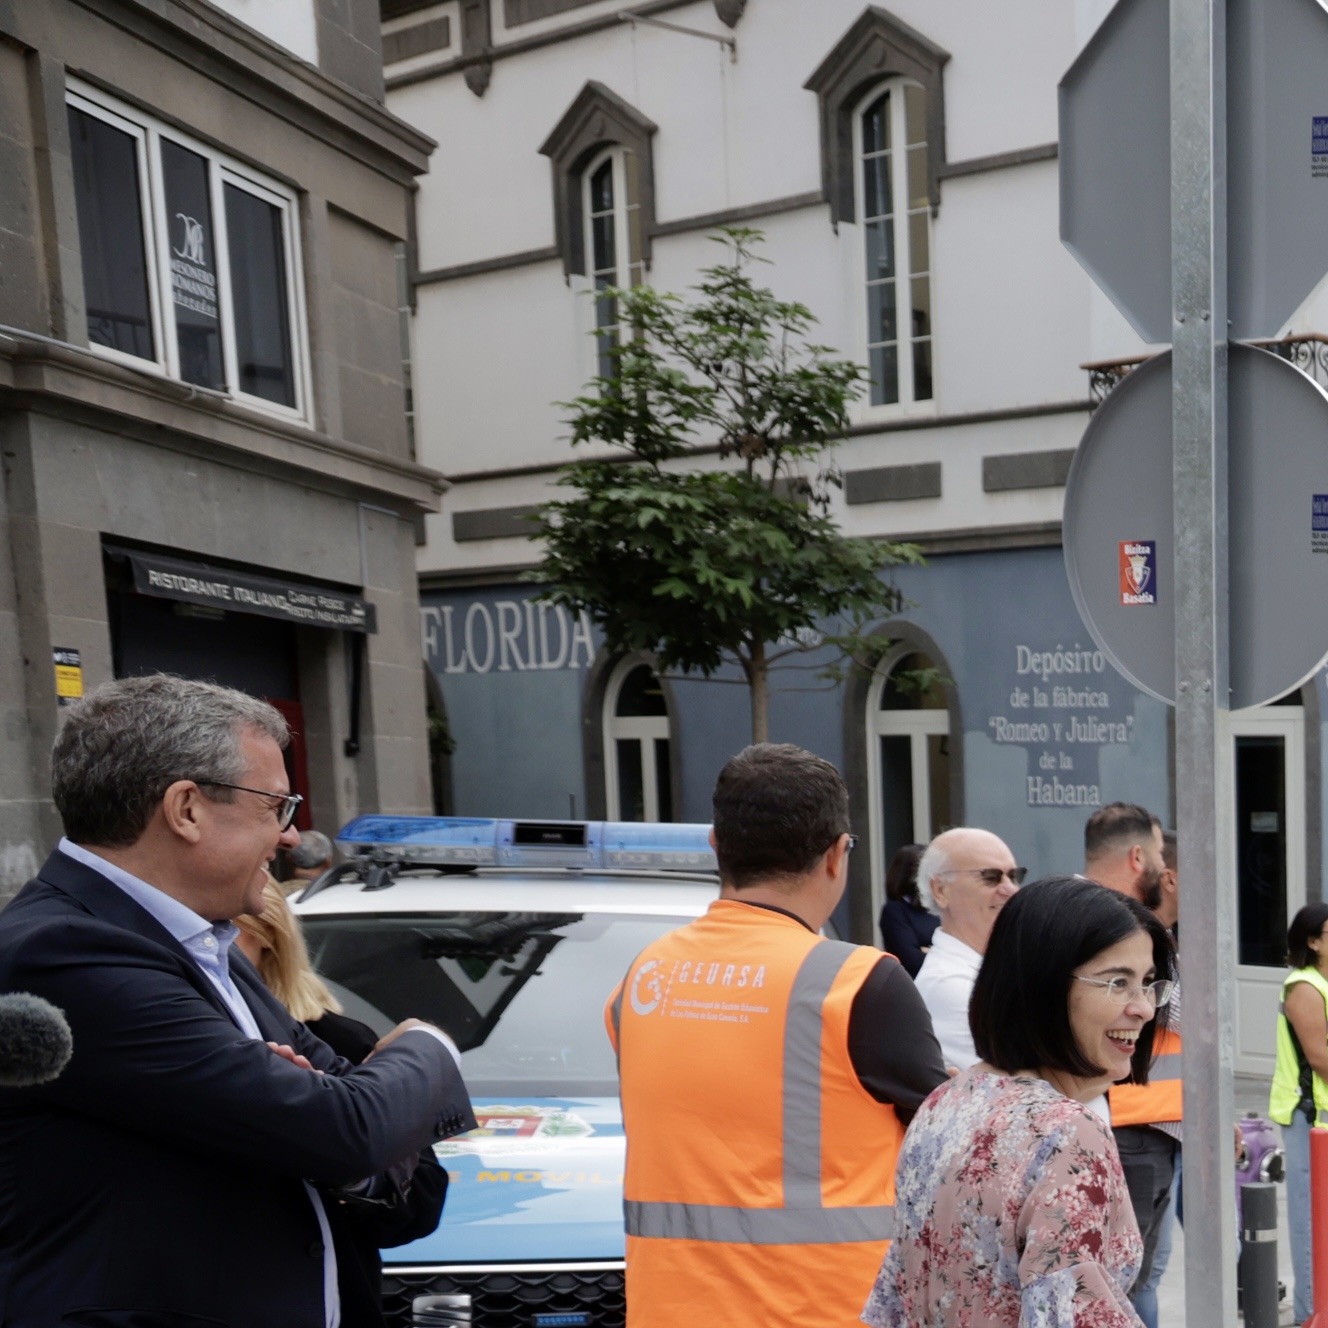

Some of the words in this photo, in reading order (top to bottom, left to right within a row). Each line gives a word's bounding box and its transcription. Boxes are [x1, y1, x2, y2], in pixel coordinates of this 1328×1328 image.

[148, 569, 232, 600] RISTORANTE
[420, 599, 597, 674] FLORIDA
[1010, 687, 1029, 708] de
[1032, 686, 1049, 708] la
[1052, 686, 1110, 708] fábrica
[1039, 752, 1057, 769] de
[1059, 751, 1074, 770] la
[1027, 775, 1101, 806] Habana
[679, 961, 767, 988] GEURSA
